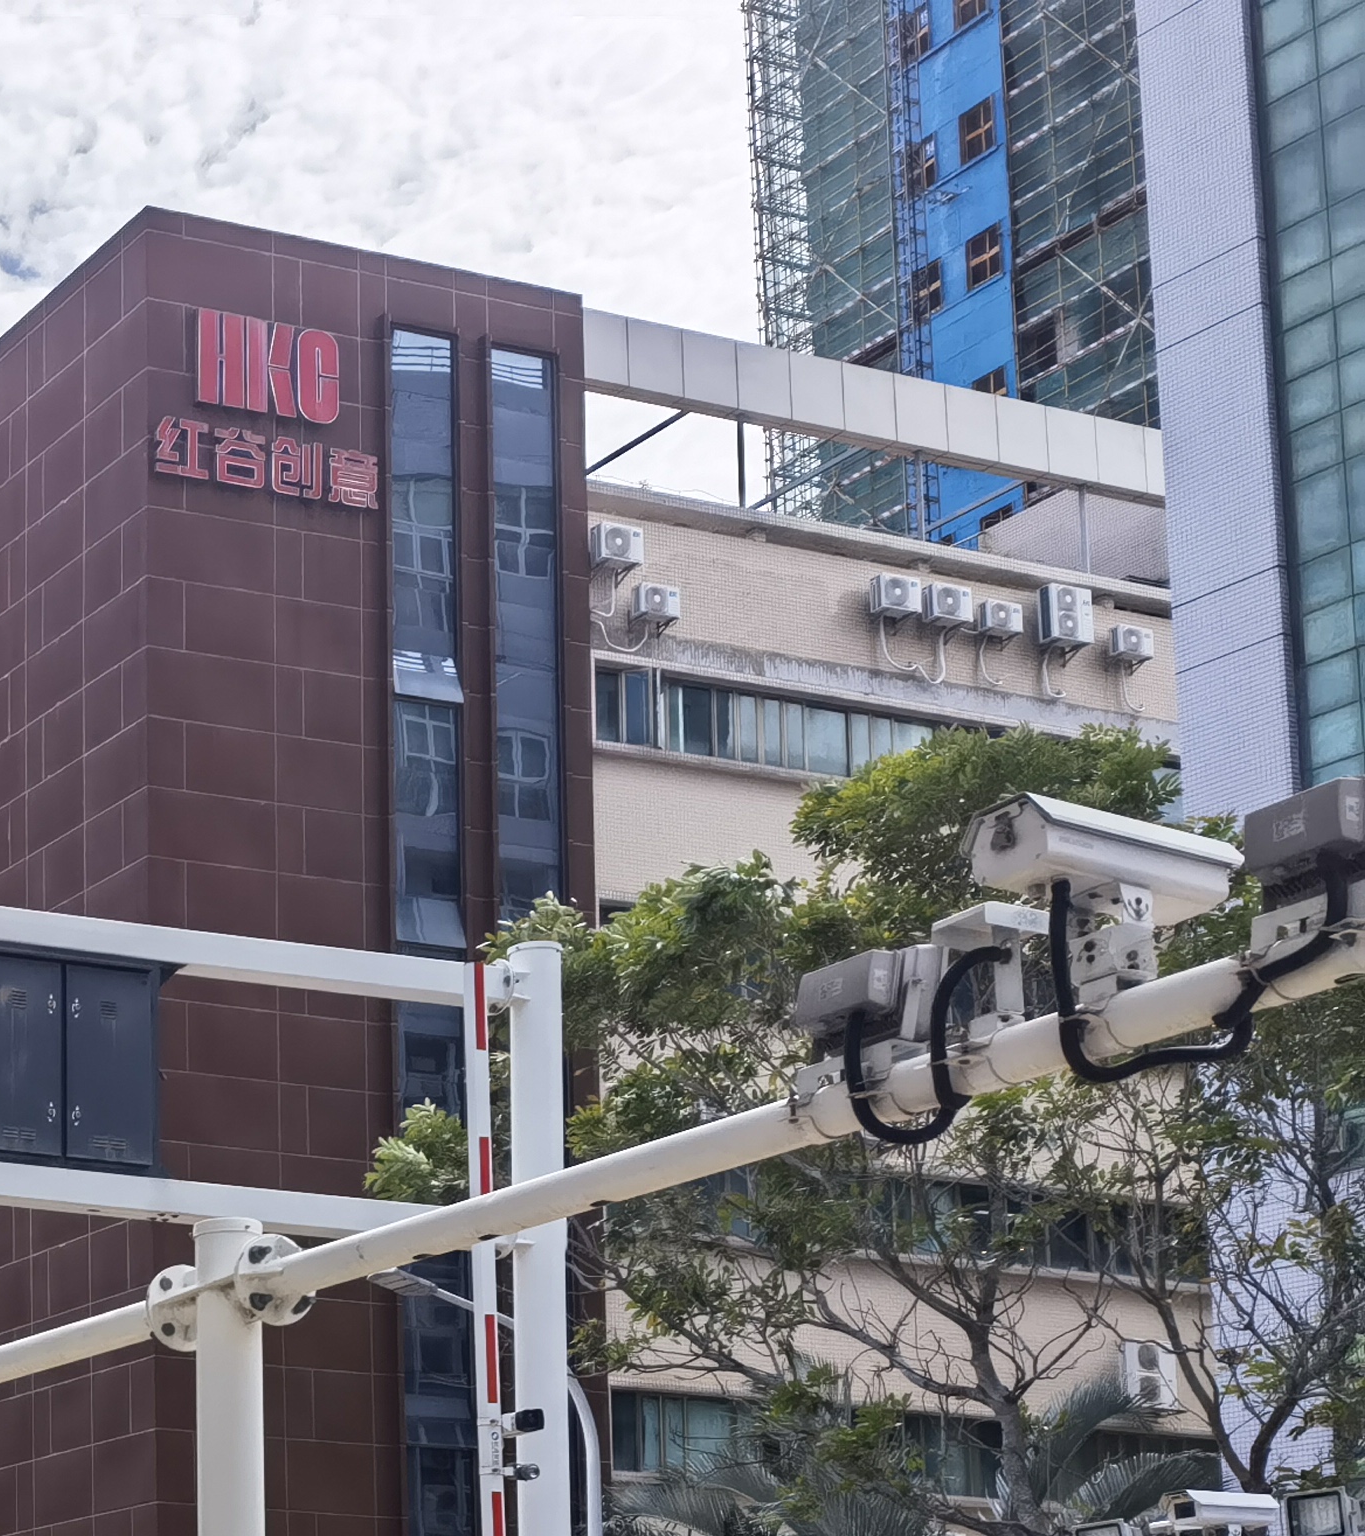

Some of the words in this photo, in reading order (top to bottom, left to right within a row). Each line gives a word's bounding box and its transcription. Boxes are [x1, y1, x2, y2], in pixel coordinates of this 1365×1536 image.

[197, 307, 340, 425] HKC
[154, 415, 379, 510] 红谷创意
